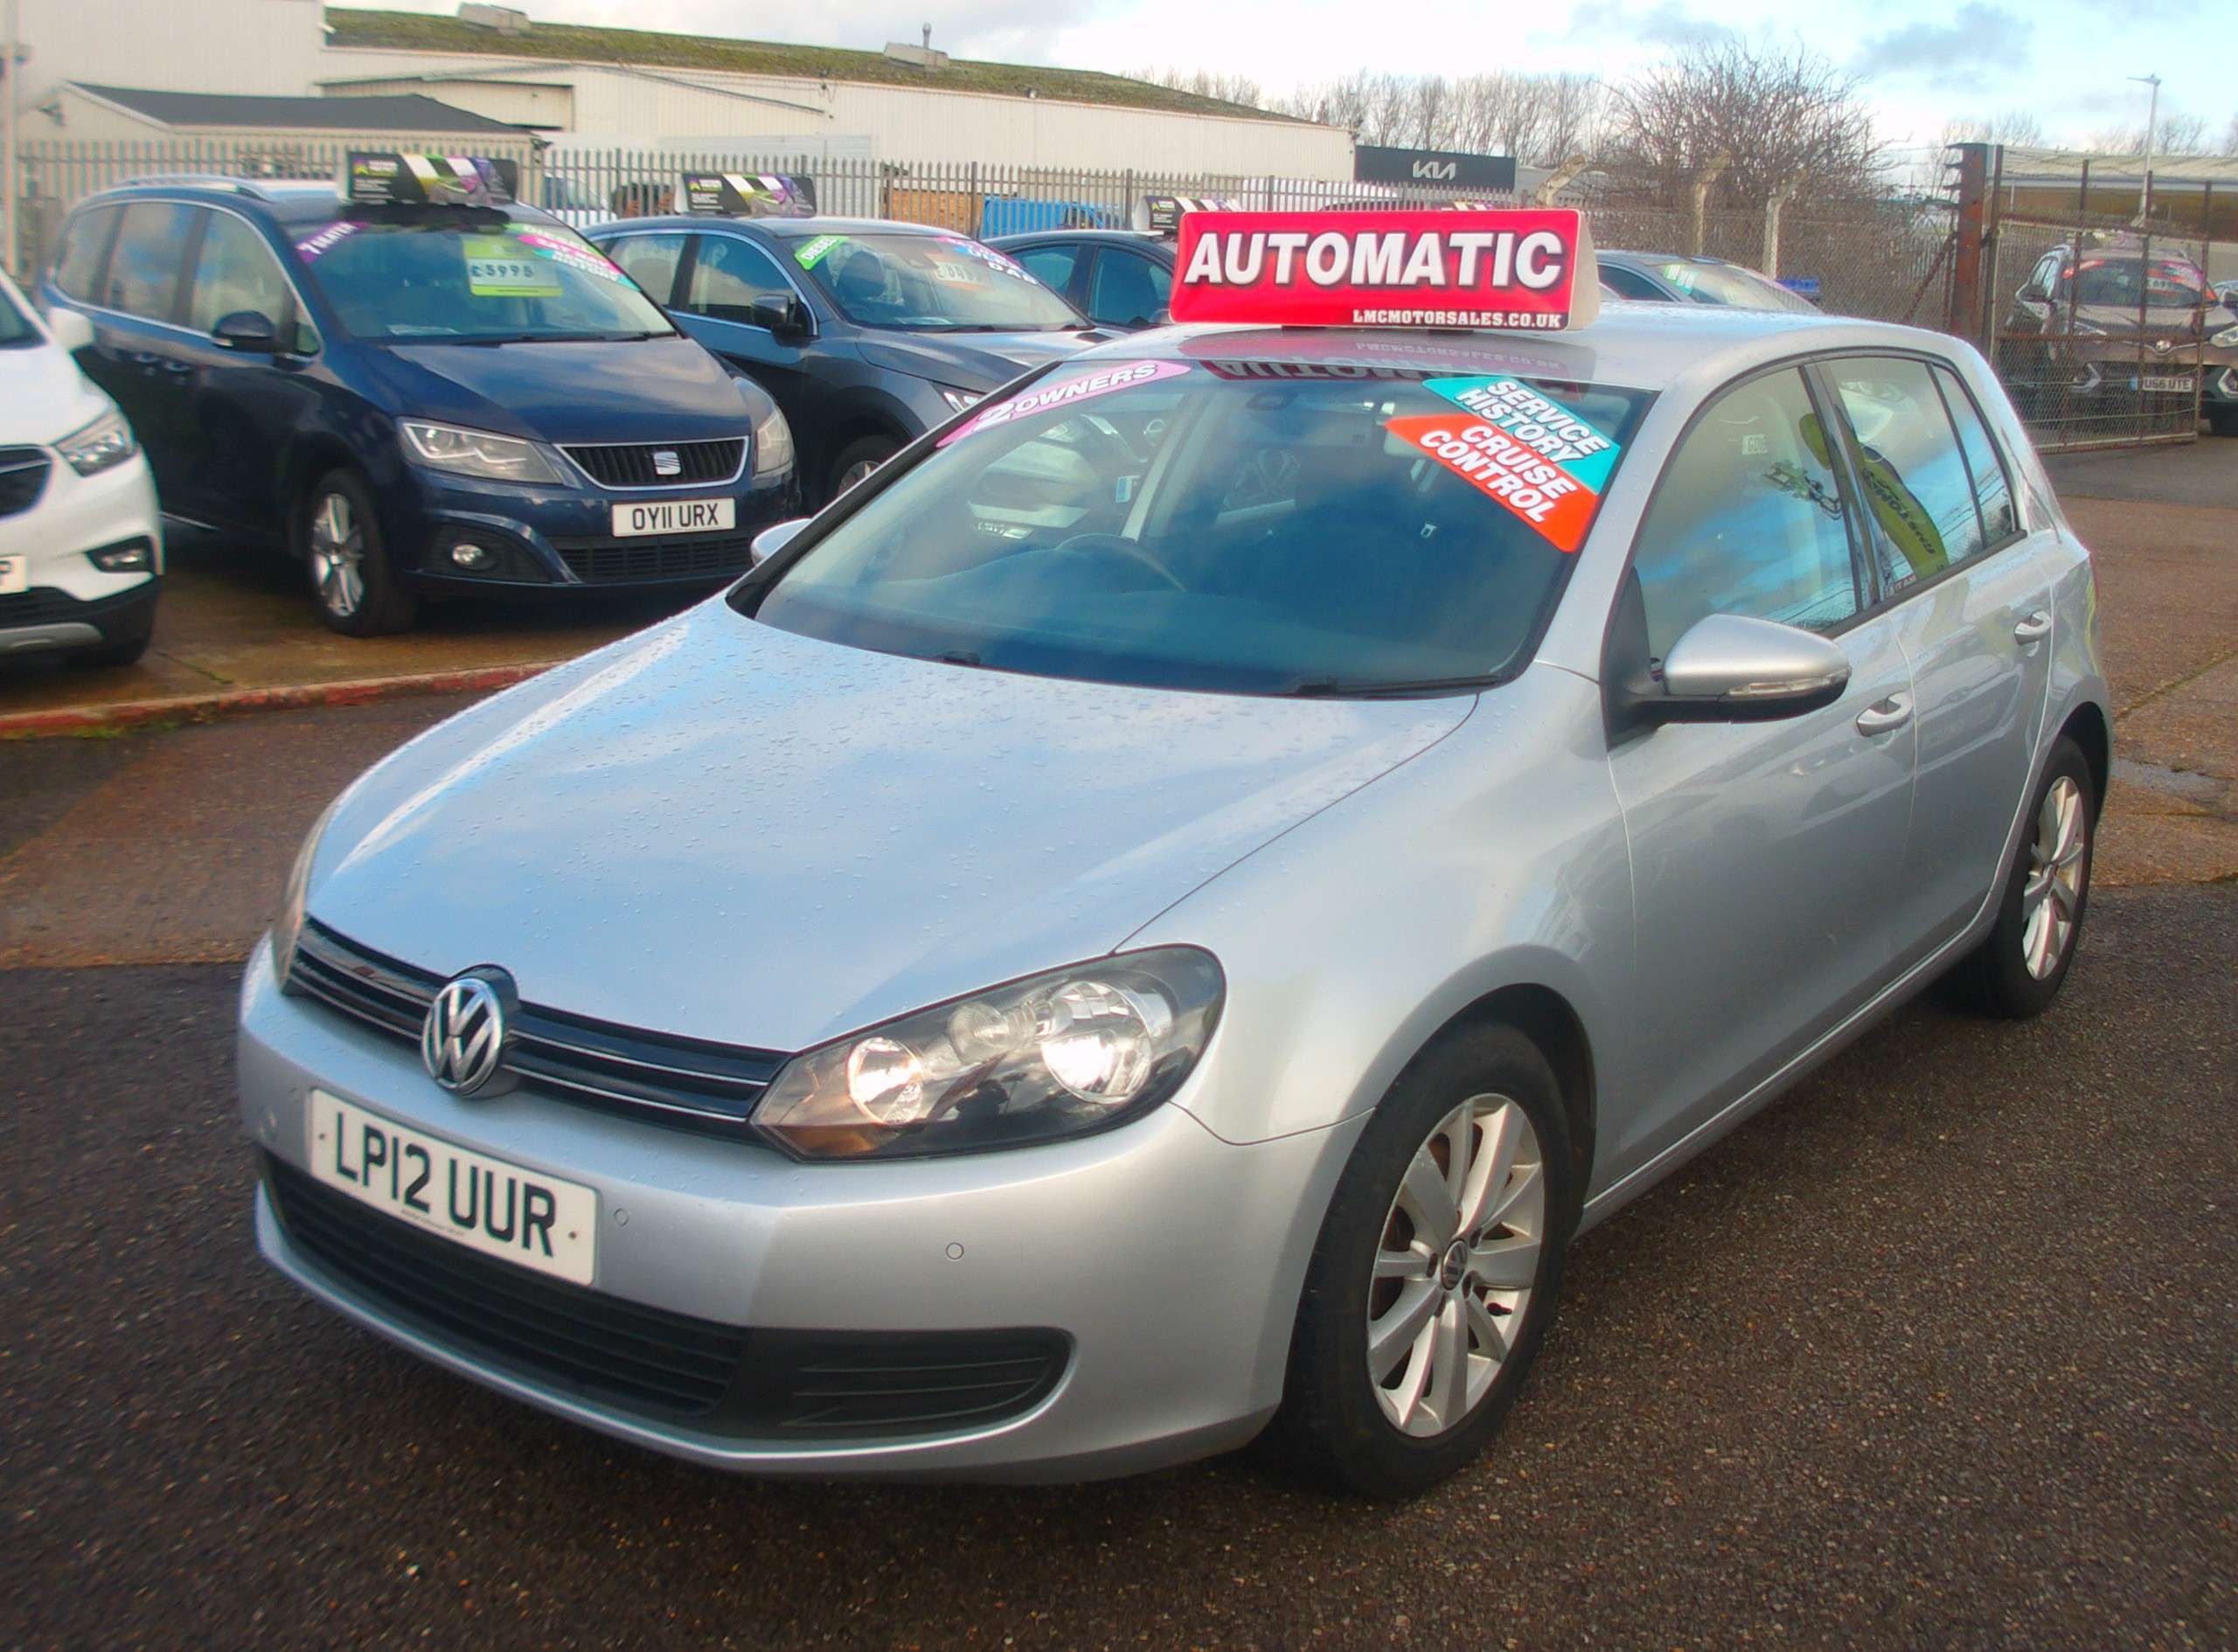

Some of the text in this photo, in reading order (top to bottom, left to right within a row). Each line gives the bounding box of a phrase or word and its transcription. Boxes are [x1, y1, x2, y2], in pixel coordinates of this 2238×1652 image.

[1184, 232, 1562, 288] AUTOMATIC
[1353, 309, 1562, 329] LMCMOTORSALES.CO.UK
[972, 402, 1015, 431] 2
[1015, 363, 1157, 413] OWNERS
[1456, 389, 1584, 463] HISTORY
[1488, 381, 1610, 455] SERVICE
[1420, 430, 1556, 523] CONTROL
[1461, 426, 1577, 499] CRUISE
[679, 503, 719, 528] URX
[336, 1111, 556, 1259] LP12 UUR
